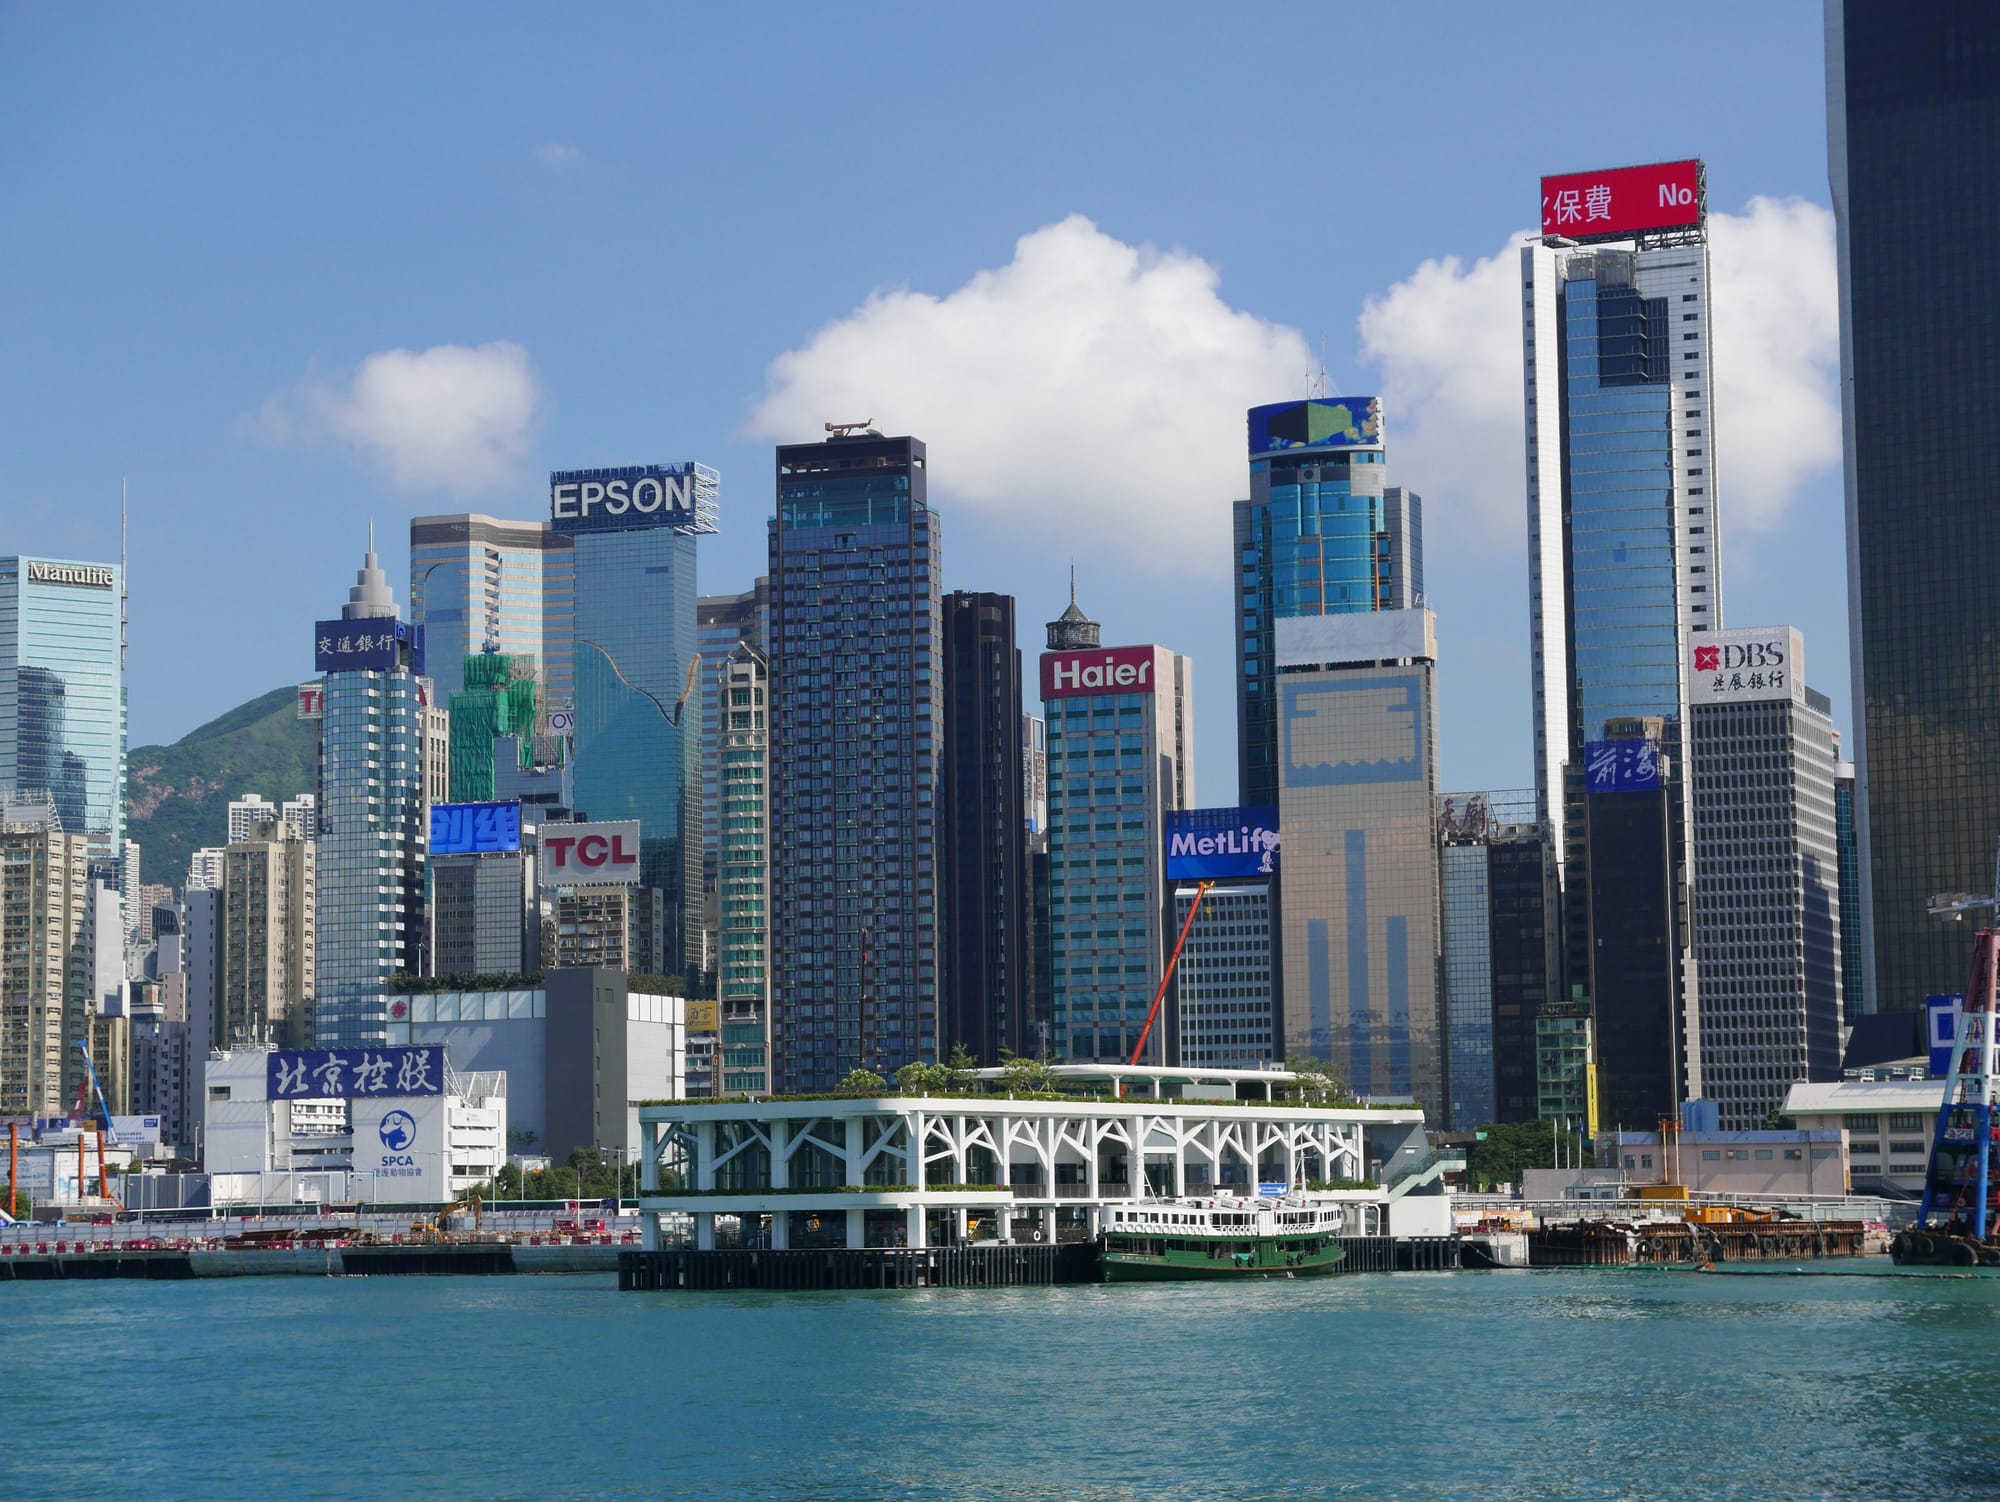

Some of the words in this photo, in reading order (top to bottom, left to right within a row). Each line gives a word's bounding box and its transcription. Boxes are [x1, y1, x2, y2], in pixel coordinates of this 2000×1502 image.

[553, 475, 691, 519] EPSON
[28, 561, 113, 585] Manulife
[319, 634, 395, 655] 交通銀行
[1724, 641, 1784, 669] DBS
[1053, 656, 1151, 690] Haier
[545, 835, 636, 867] TCL
[1170, 826, 1263, 857] MetLif
[275, 1050, 438, 1095] 北京控股
[381, 1155, 414, 1167] SPCA
